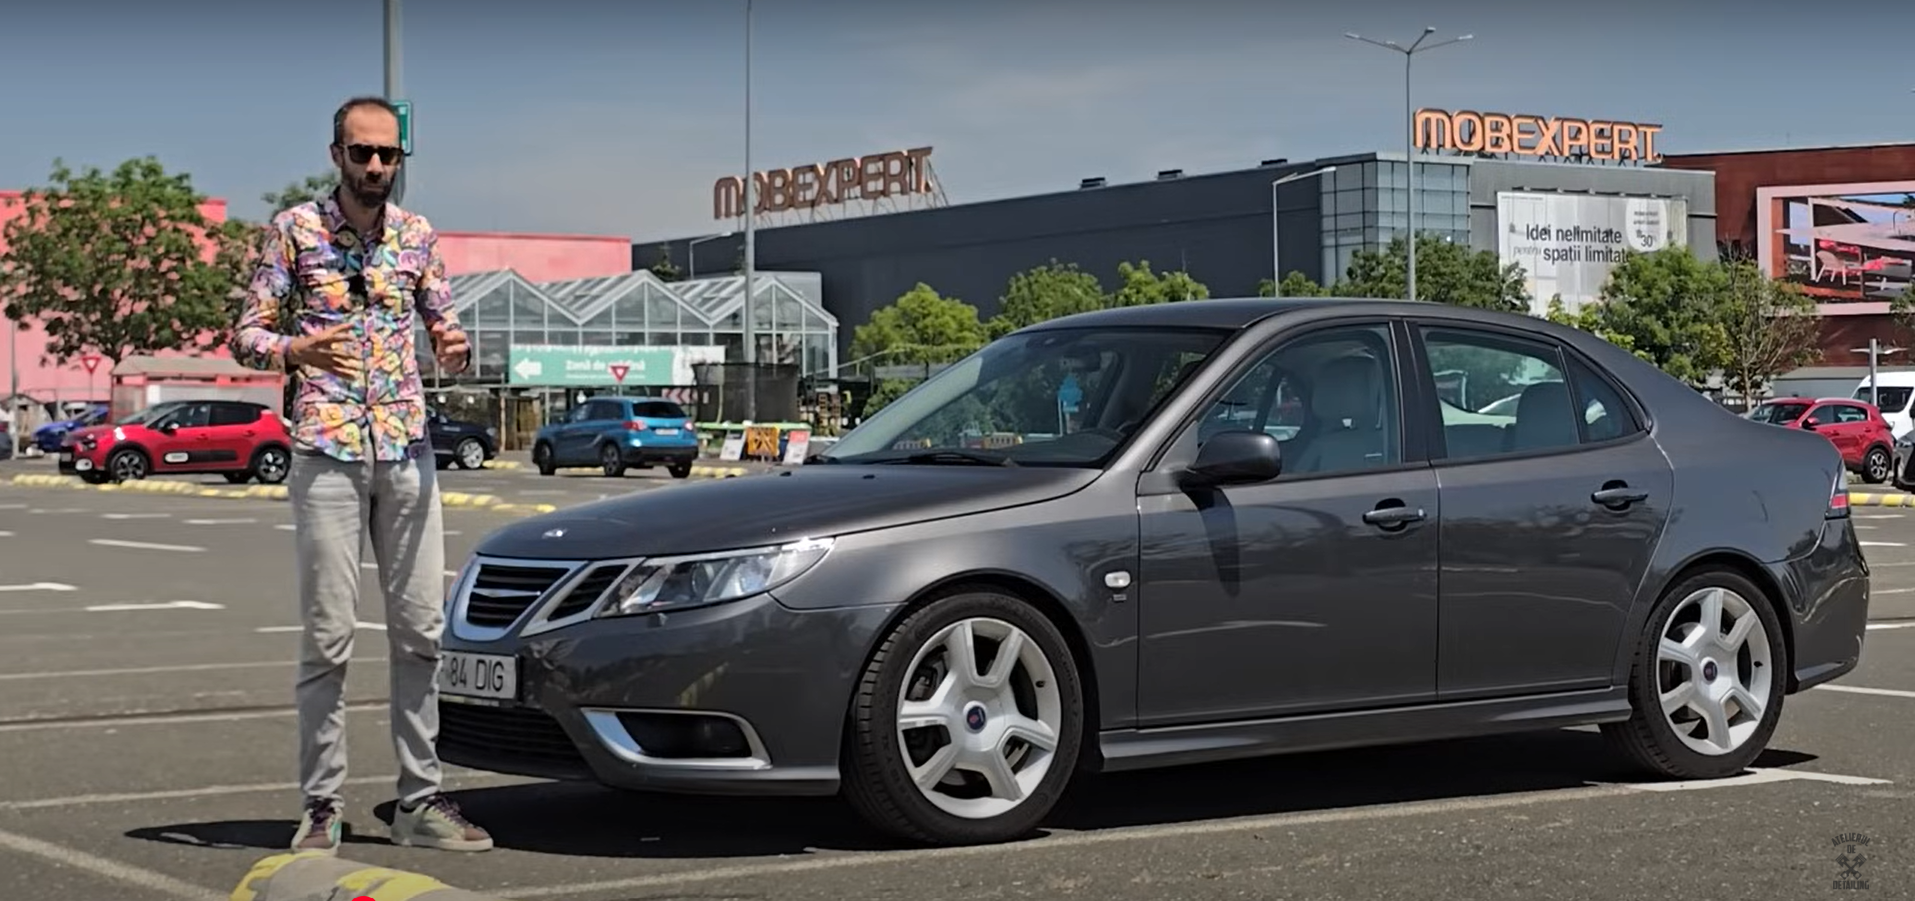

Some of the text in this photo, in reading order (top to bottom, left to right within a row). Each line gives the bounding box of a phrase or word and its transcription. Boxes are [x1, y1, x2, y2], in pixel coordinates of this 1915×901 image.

[1526, 224, 1551, 241] Idei
[1556, 225, 1622, 244] nelimitate
[451, 657, 467, 688] 84
[475, 659, 504, 692] DIG
